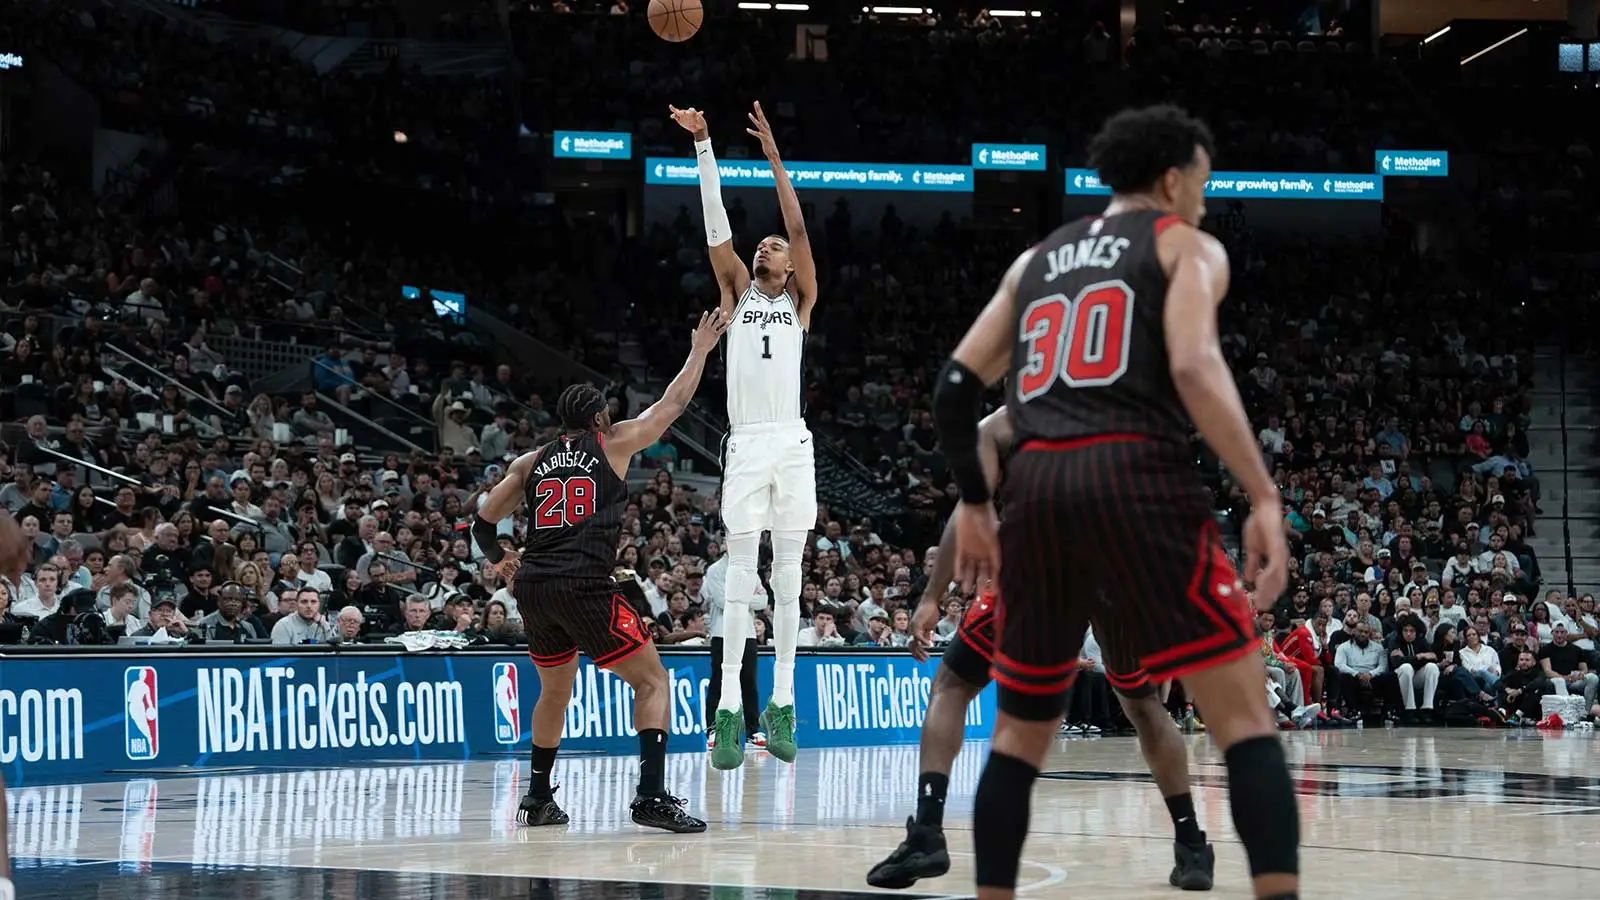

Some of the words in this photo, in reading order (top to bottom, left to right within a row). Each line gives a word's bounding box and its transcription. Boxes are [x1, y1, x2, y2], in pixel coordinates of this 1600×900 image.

[574, 137, 624, 150] Methodist
[991, 149, 1039, 161] Methodist
[1394, 156, 1440, 168] Methodist
[719, 166, 752, 178] We're
[797, 170, 822, 182] your
[823, 169, 867, 183] growing
[867, 170, 903, 184] family.
[923, 171, 965, 182] Methodist
[1210, 180, 1234, 191] your
[1236, 178, 1278, 192] growing
[1279, 179, 1314, 193] family.
[1334, 180, 1375, 190] Methodist
[1044, 234, 1131, 282] JONES
[742, 310, 793, 327] SPURS
[761, 335, 772, 359] 1
[1016, 279, 1135, 404] 30
[534, 450, 600, 477] YABUSELE
[535, 476, 597, 530] 28
[196, 665, 465, 754] NBATickets.com
[130, 738, 147, 754] NBA
